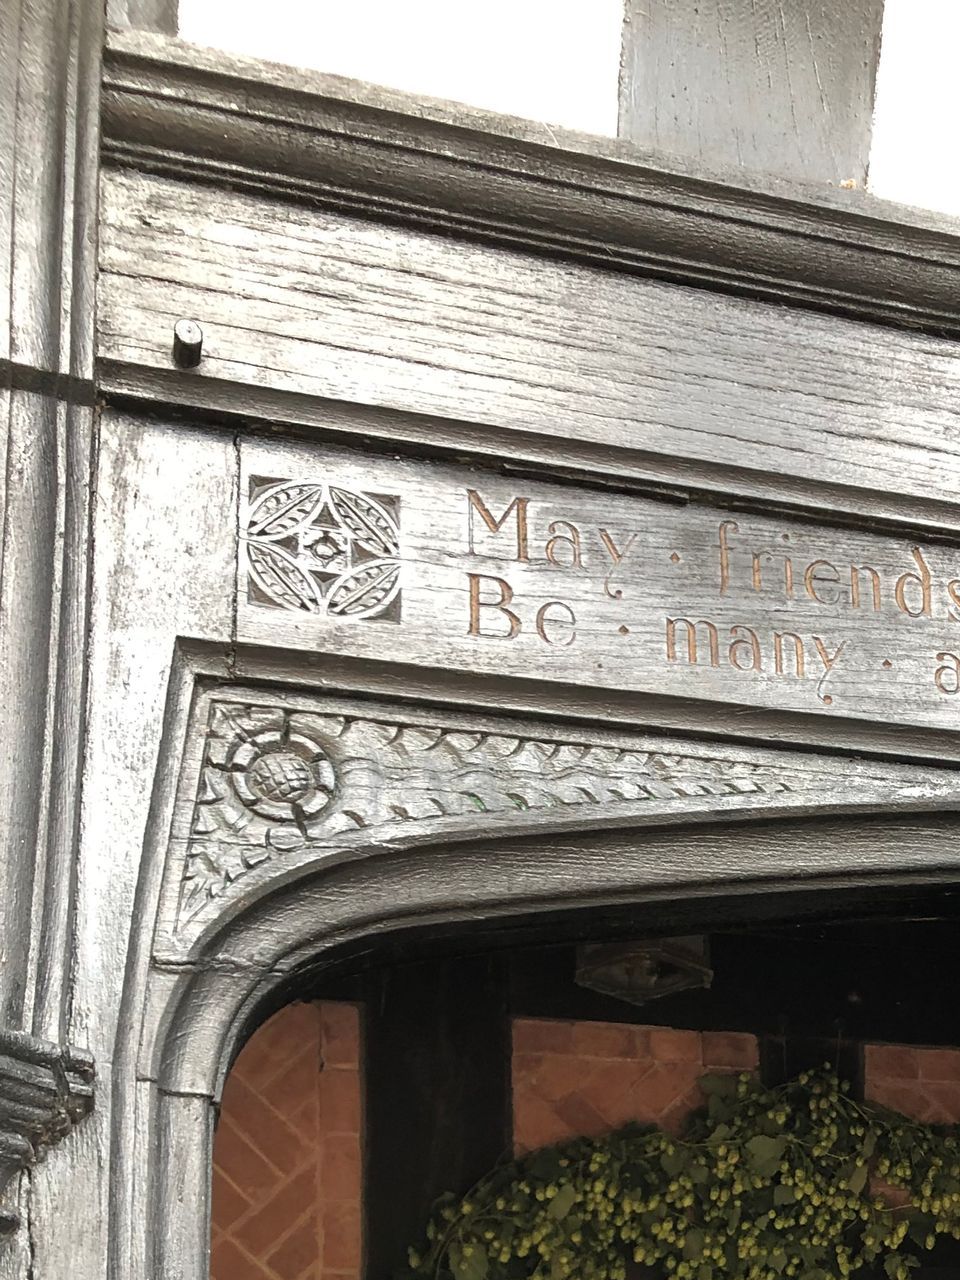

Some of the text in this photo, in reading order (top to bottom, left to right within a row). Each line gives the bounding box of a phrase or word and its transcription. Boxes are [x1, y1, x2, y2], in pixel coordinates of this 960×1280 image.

[466, 488, 638, 599] May
[466, 572, 577, 647] Be
[665, 616, 847, 706] many
